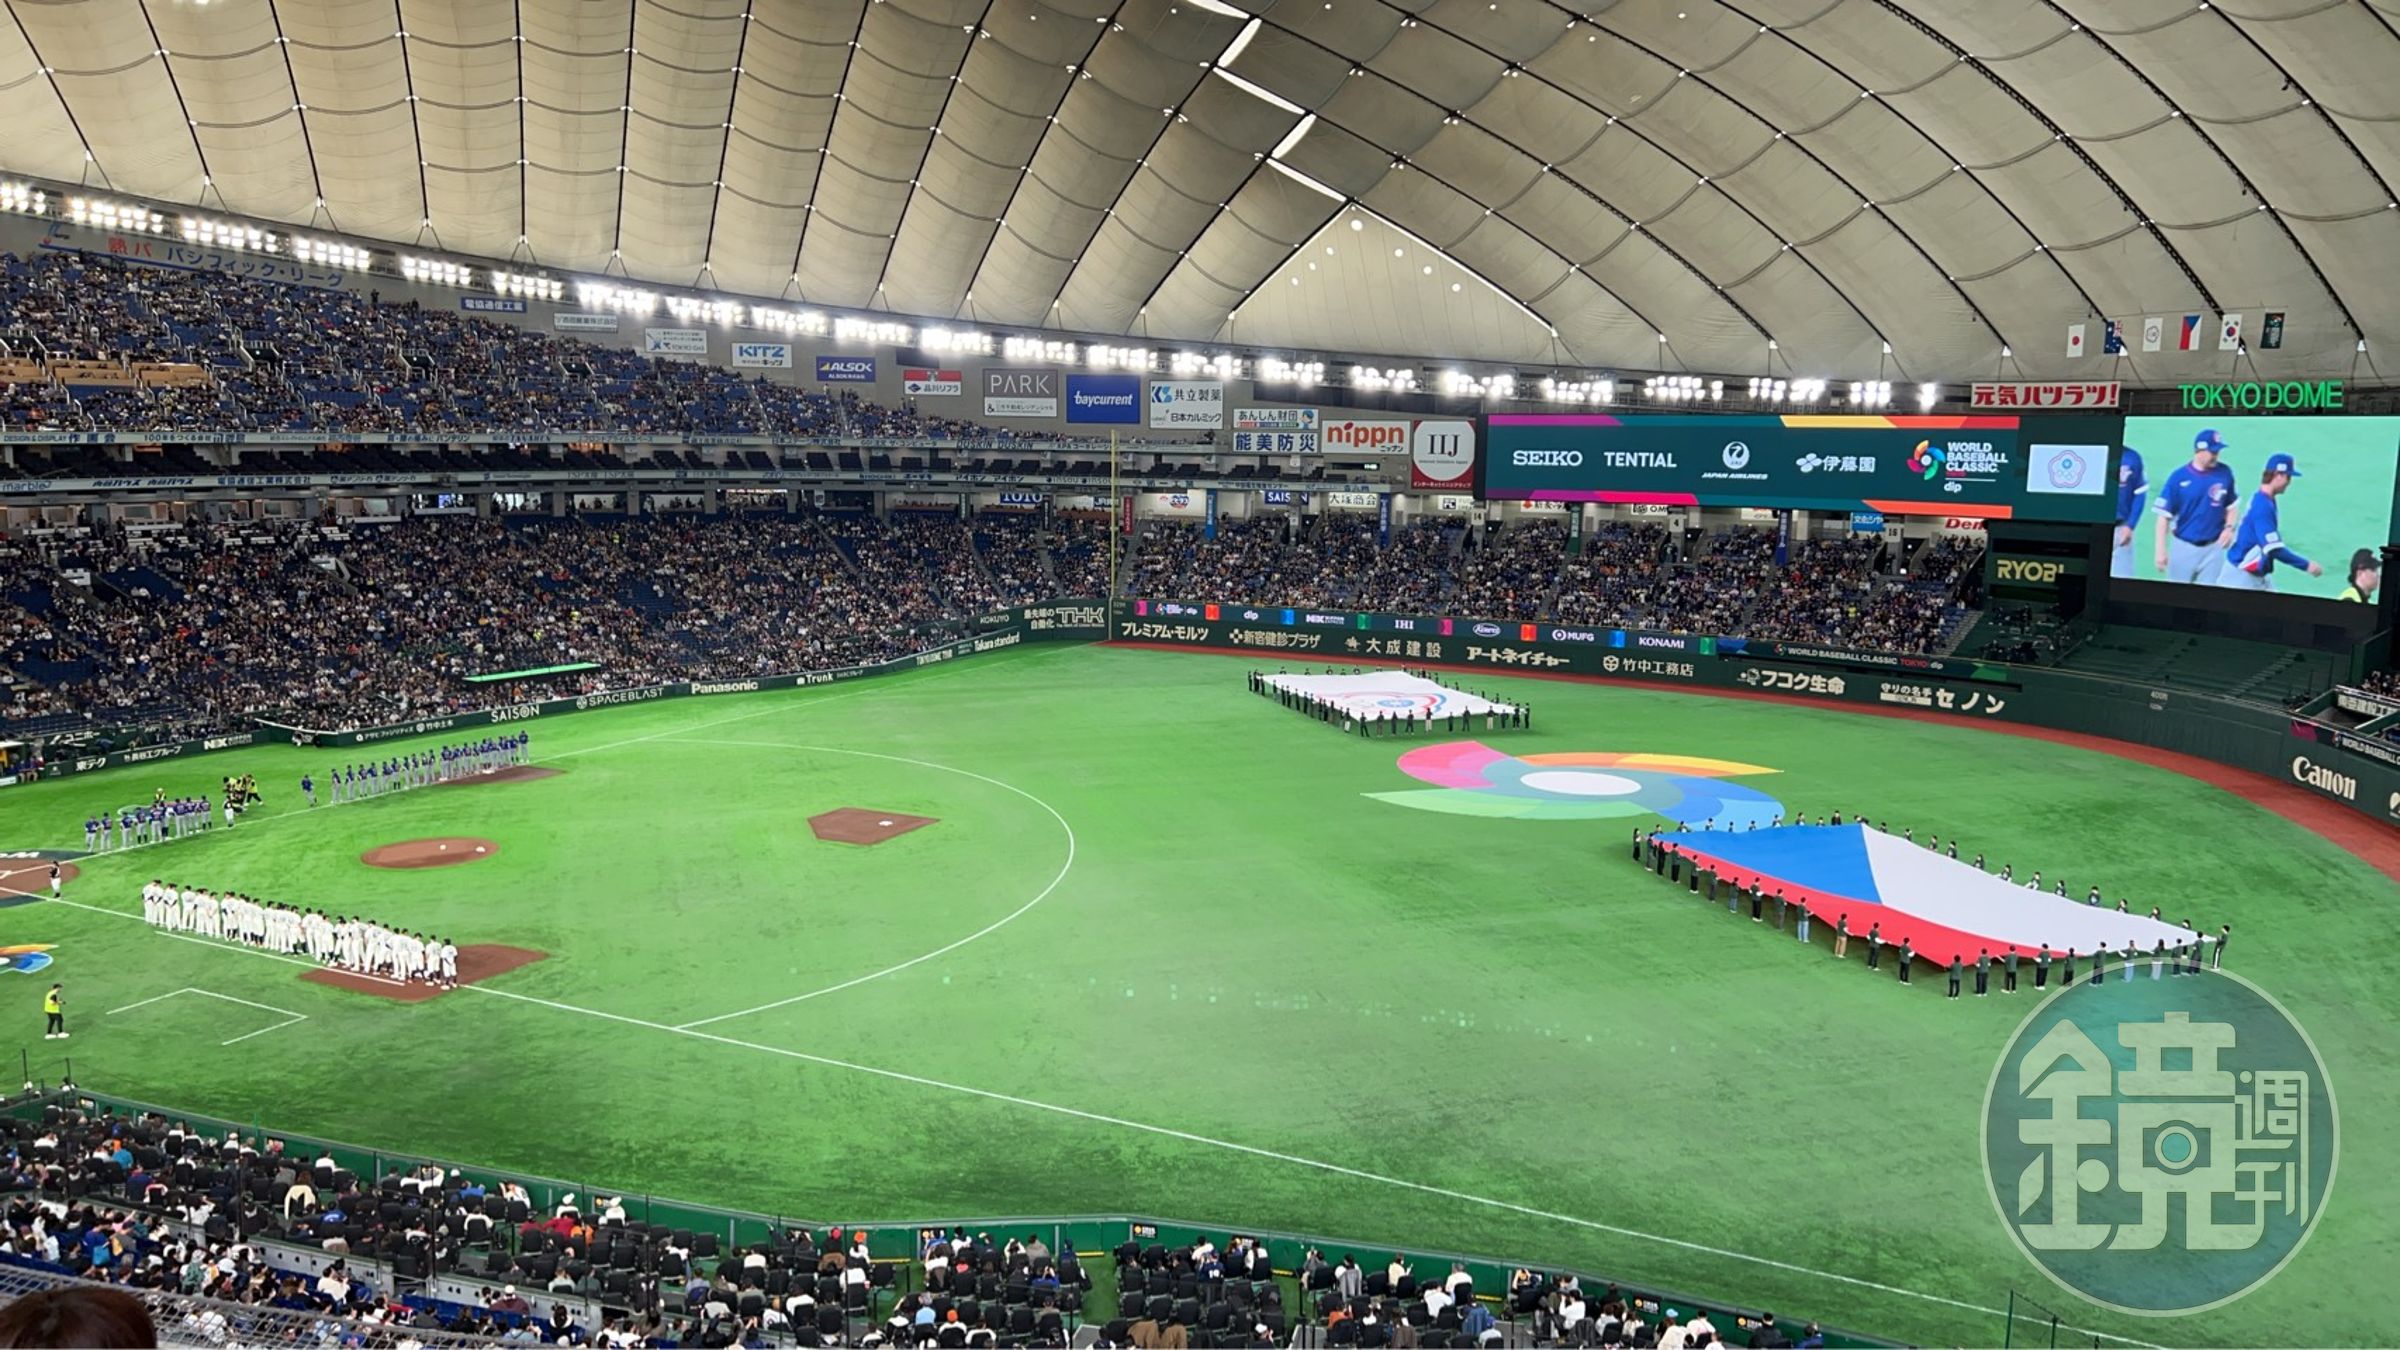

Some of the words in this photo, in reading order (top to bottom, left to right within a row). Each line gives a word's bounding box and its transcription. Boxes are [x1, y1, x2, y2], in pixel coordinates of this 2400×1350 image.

[168, 247, 344, 287] パシフィック・リーグ
[739, 345, 784, 357] KITZ
[830, 362, 872, 372] ALSOK
[924, 384, 958, 392] 品川リフラ
[991, 374, 1050, 394] PARK
[1074, 390, 1133, 408] baycurrent
[1174, 388, 1221, 402] 共立製薬
[1972, 383, 2118, 407] 元気ハツラツ!
[2178, 383, 2260, 409] TOKYO
[2264, 381, 2344, 408] DOME
[1171, 412, 1222, 422] 日本カルミック
[1239, 410, 1297, 421] あんしん財団
[1236, 434, 1315, 451] 能美防災
[1327, 422, 1404, 447] nippn
[1428, 434, 1461, 457] IIJ
[1947, 442, 1992, 452] WORLD
[1513, 450, 1583, 466] SEIKO
[1604, 451, 1677, 468] TENTIAL
[1823, 455, 1876, 473] 伊藤園
[1946, 451, 2008, 463] BASEBALL
[1945, 462, 1999, 473] CLASSIC
[1944, 481, 1962, 493] dip
[1002, 492, 1042, 502] TOTO
[1267, 492, 1308, 504] SAISN
[1330, 494, 1377, 506] 大塚商会
[980, 614, 1009, 624] KOKUYO
[1056, 607, 1105, 623] THK
[1243, 610, 1259, 621] dip
[1121, 622, 1208, 641] プレミアム・モルツ
[1394, 619, 1414, 630] IHI
[974, 639, 994, 652] Takara
[994, 631, 1020, 648] standard
[1243, 630, 1321, 648] 新宿健診プラザ
[1568, 631, 1595, 642] MUFG
[1639, 636, 1685, 649] KONAMI
[1366, 638, 1442, 659] 大成建設
[1466, 646, 1570, 667] アートネイチャー
[1788, 647, 1818, 657] WORLD
[1819, 650, 1860, 661] BASEBALL
[1861, 655, 1898, 665] CLASSIC
[1900, 658, 1928, 668] TOKYO
[1930, 661, 1944, 670] dip
[1623, 658, 1694, 677] 竹中工務店
[805, 673, 834, 685] Trunk
[1762, 670, 1846, 695] フコク生命
[691, 680, 759, 695] Panasonic
[1880, 682, 1932, 697] 守りの名手
[588, 687, 664, 707] SPACEBLAST
[1936, 687, 2005, 714] セノン
[491, 704, 540, 723] SAISON
[2342, 736, 2365, 752] WORLD
[2292, 756, 2356, 800] Canon
